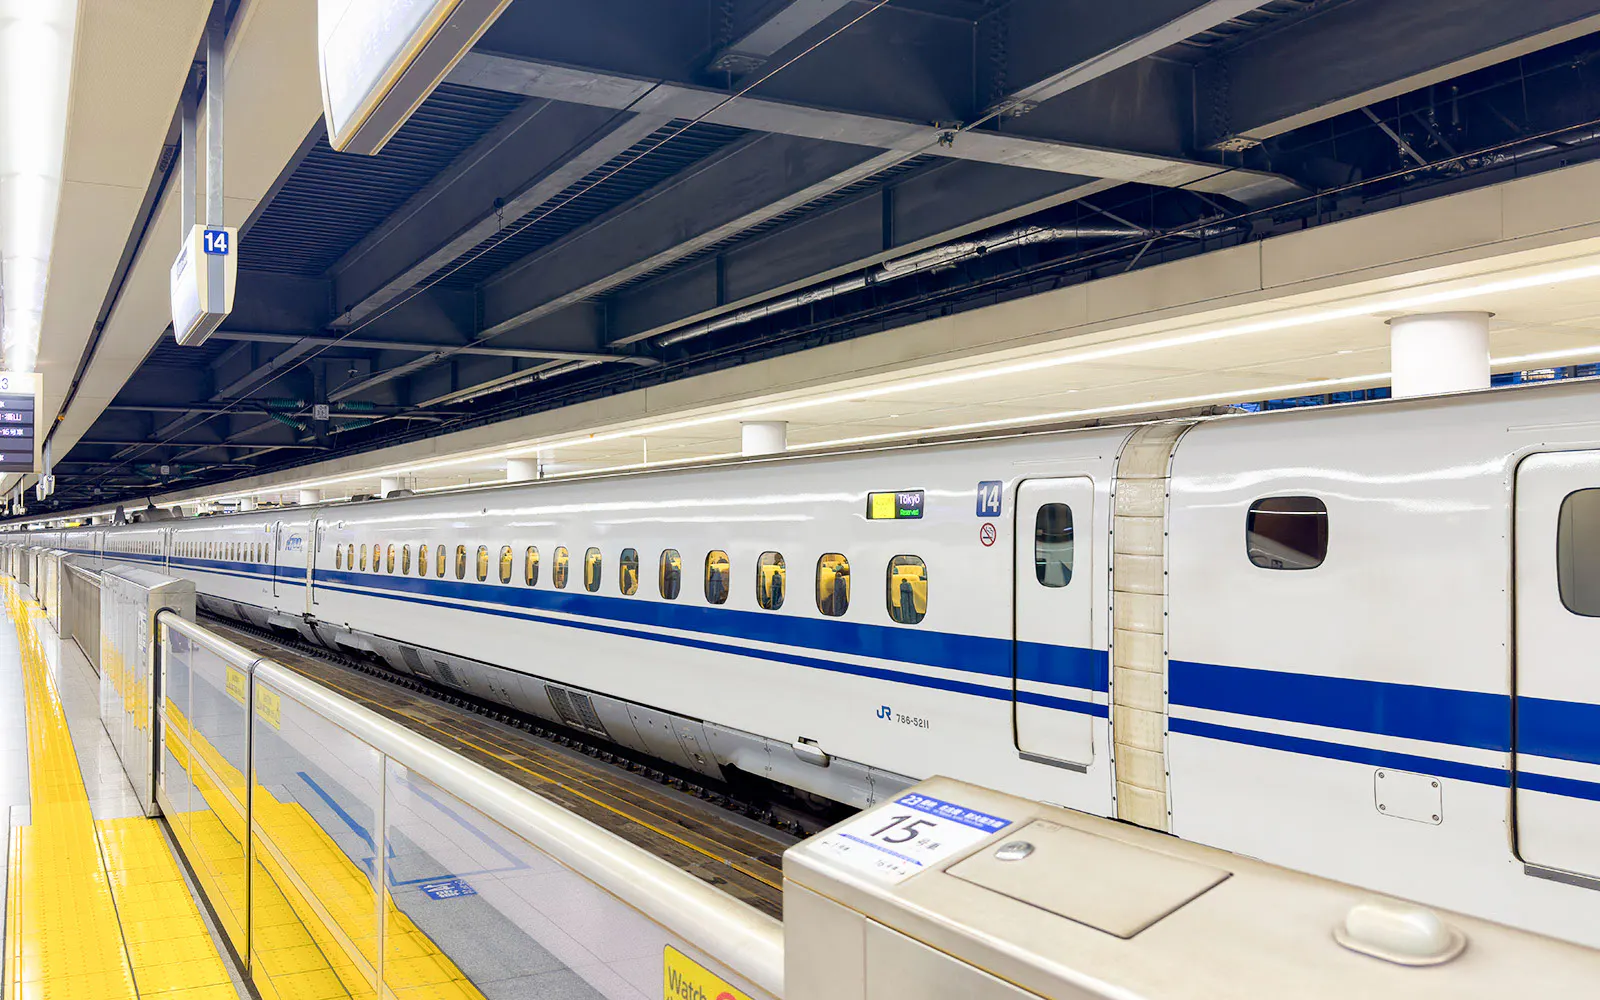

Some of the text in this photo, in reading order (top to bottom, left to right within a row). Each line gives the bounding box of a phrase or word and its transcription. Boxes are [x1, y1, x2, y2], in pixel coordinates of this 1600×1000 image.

[204, 232, 227, 252] 14
[0, 377, 9, 390] 3
[979, 485, 999, 513] 14
[876, 705, 930, 729] JR 786-5211
[900, 795, 923, 806] 23
[870, 815, 937, 844] 15
[668, 965, 708, 1000] Watch
